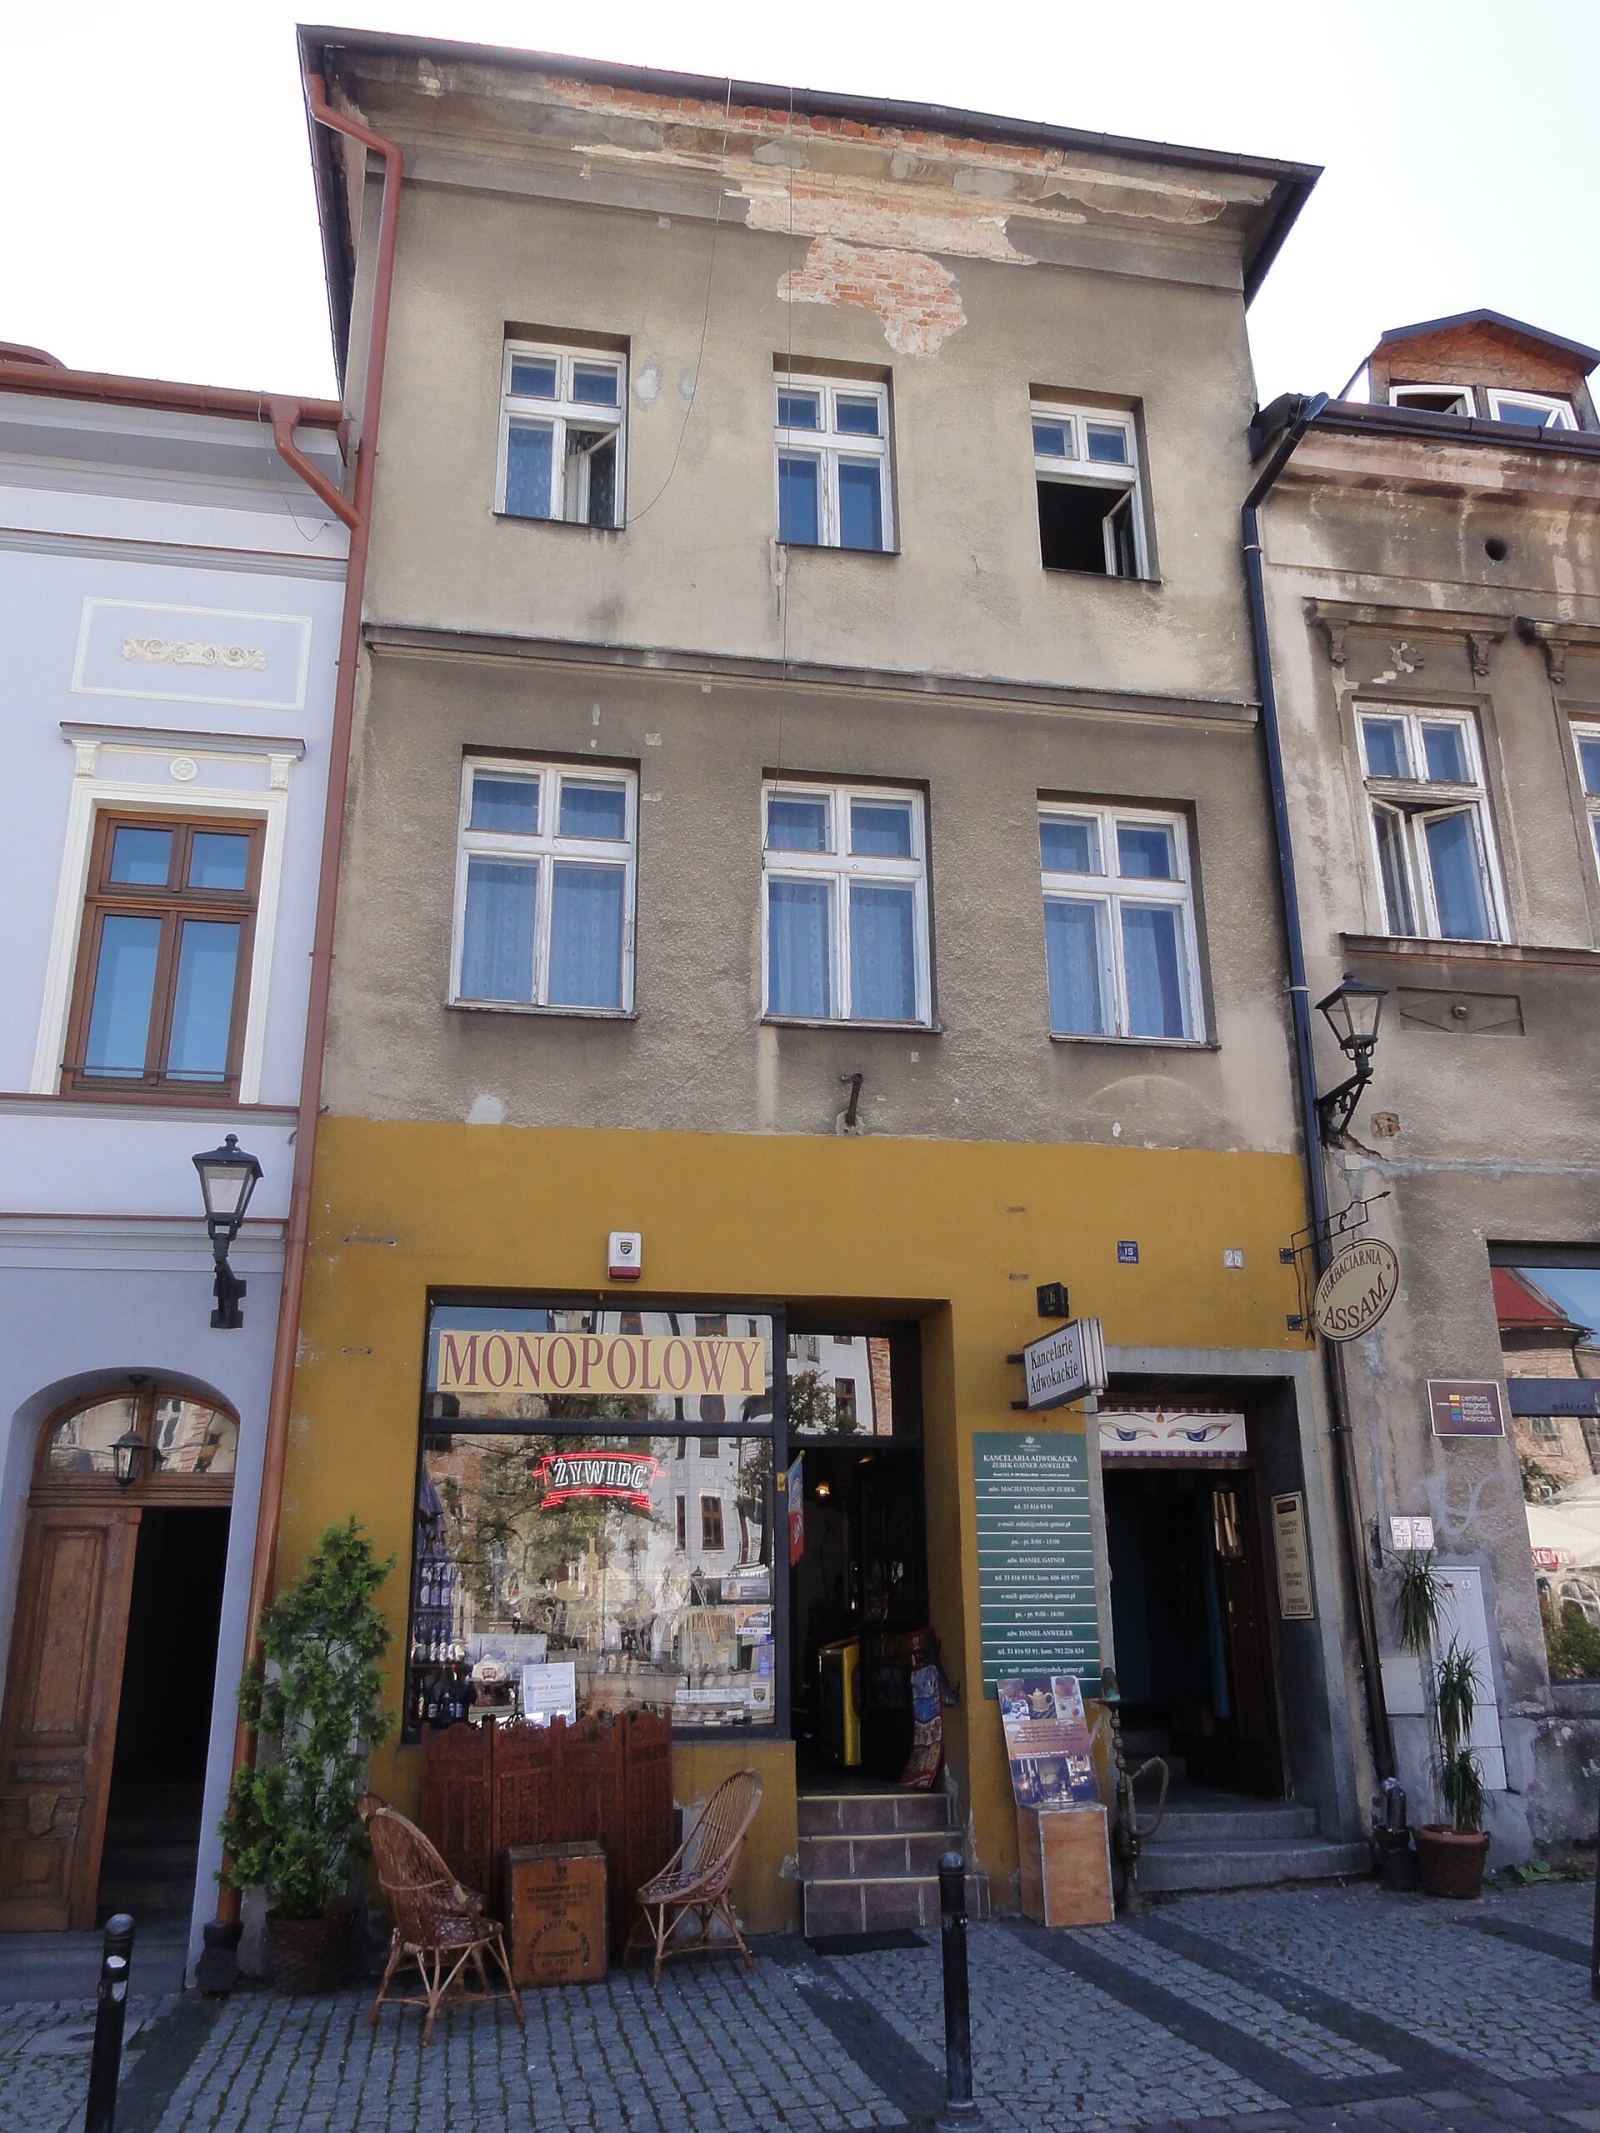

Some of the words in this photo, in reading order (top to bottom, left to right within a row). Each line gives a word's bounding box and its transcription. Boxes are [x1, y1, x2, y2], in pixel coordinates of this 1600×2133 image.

[1124, 1247, 1133, 1255] 15
[1225, 1249, 1242, 1266] 26
[1321, 1249, 1382, 1303] HERBACIARNIA
[1323, 1272, 1388, 1330] ASSAM
[440, 1334, 760, 1391] MONOPOLOWY
[1030, 1335, 1073, 1371] Kancelarie
[1030, 1360, 1079, 1395] Adwokackie
[554, 1457, 647, 1488] ŻYWIEC
[983, 1454, 1031, 1462] KANCELARIA
[1031, 1455, 1078, 1463] ADWOKACKA
